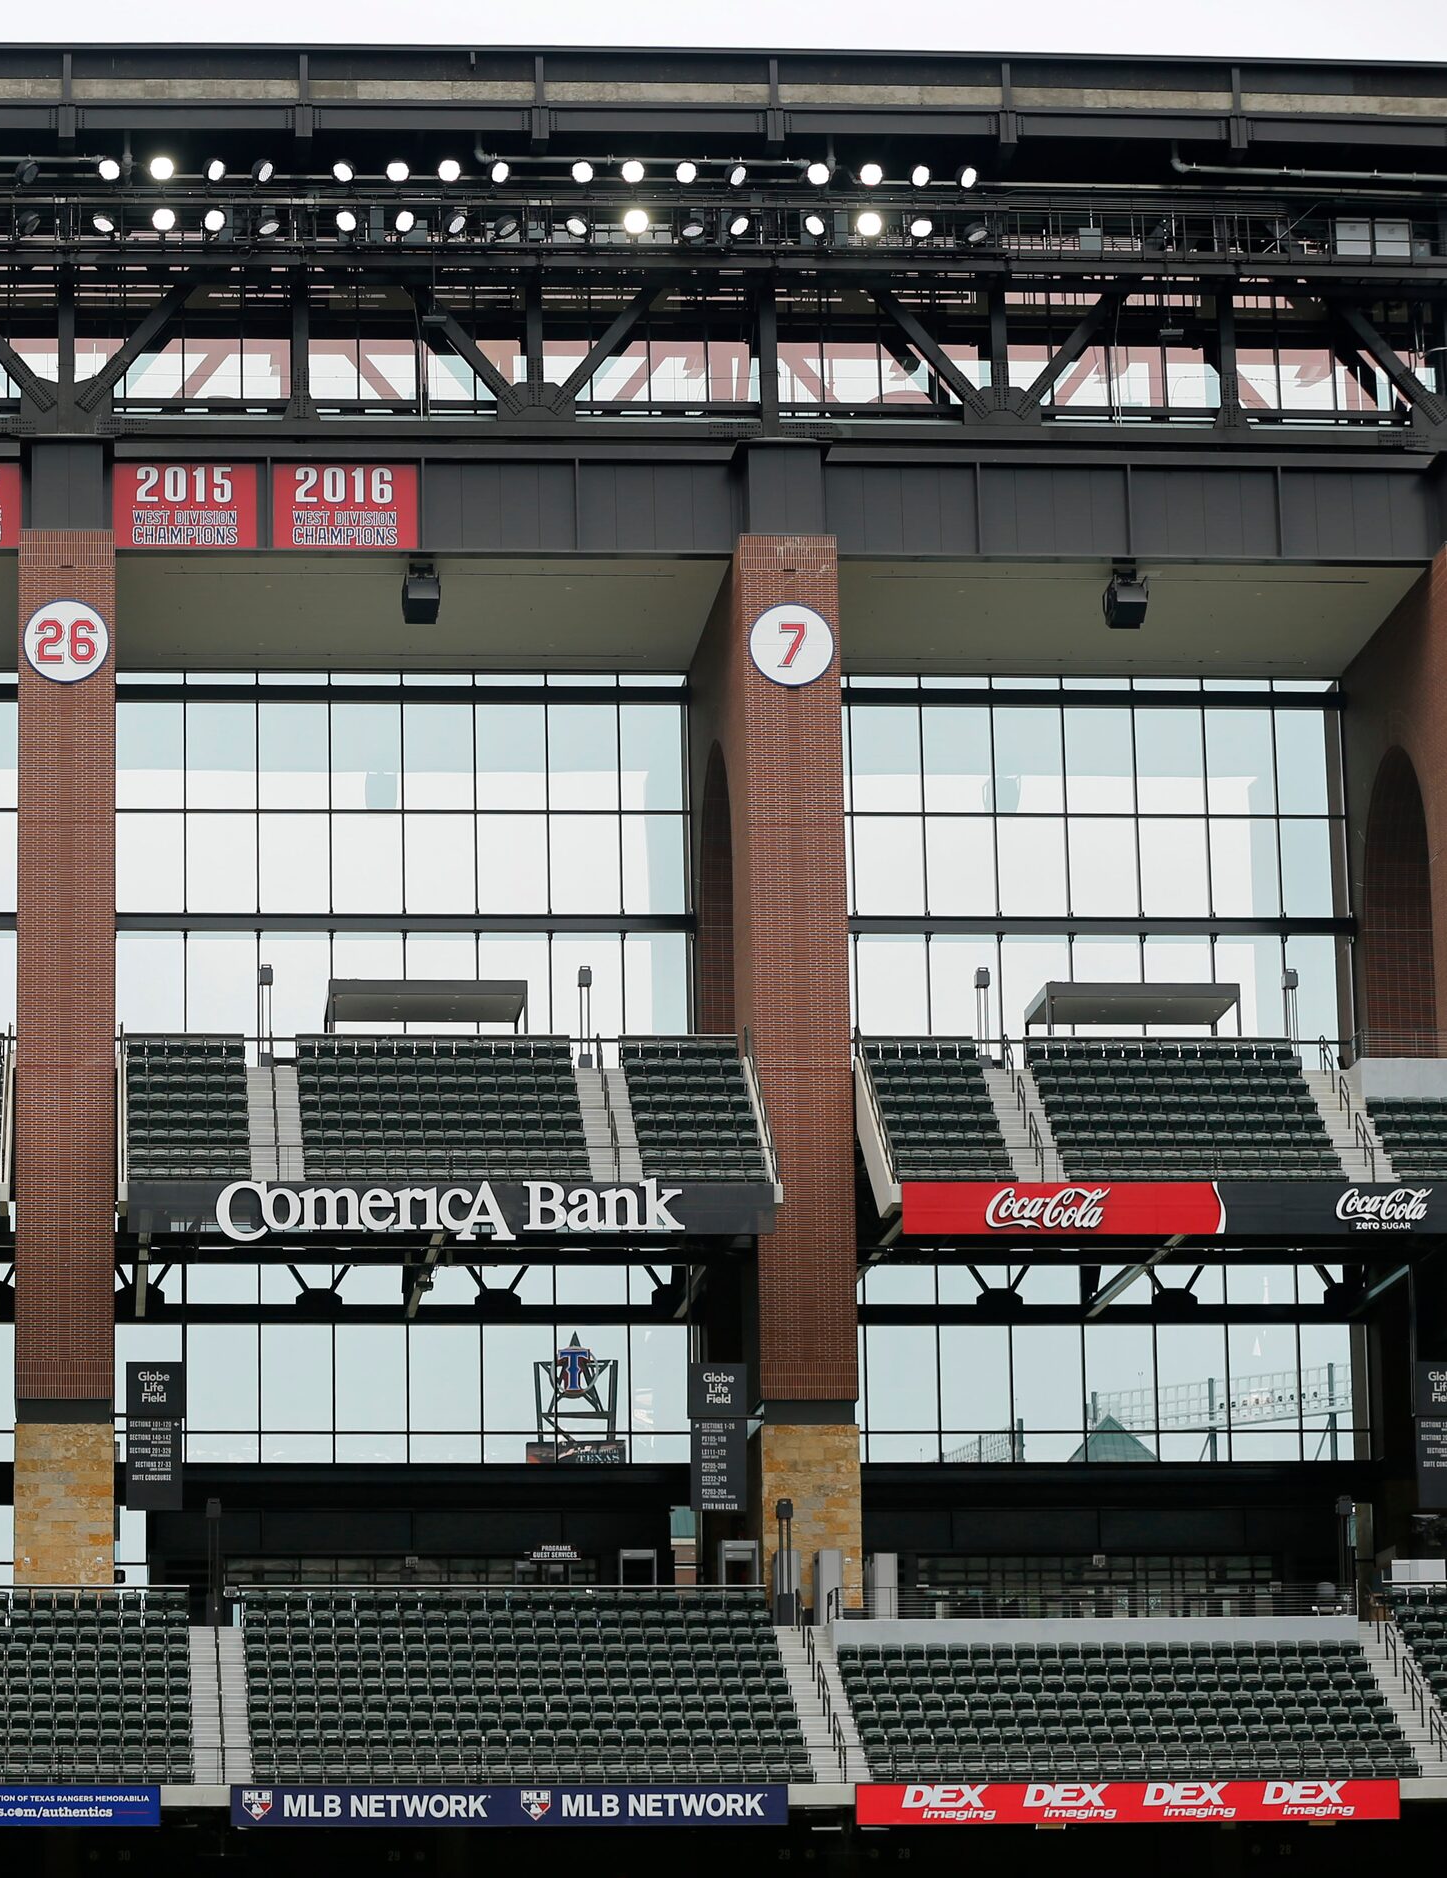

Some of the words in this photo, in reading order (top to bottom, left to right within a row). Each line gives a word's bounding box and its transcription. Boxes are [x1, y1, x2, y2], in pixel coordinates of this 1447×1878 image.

[136, 466, 232, 503] 2015
[295, 467, 393, 504] 2016
[132, 510, 170, 525] WEST
[175, 510, 237, 526] DIVISION
[292, 510, 330, 526] WEST
[335, 511, 397, 527] DIVISION
[132, 526, 238, 545] CHAMPIONS
[292, 527, 397, 546] CHAMPIONS
[34, 618, 98, 664] 26
[777, 621, 808, 667] 7
[522, 1177, 685, 1231] Bank
[985, 1187, 1110, 1229] Coca-Cola
[1335, 1188, 1433, 1221] Coca-Cola
[1355, 1222, 1380, 1230] zero
[1382, 1222, 1411, 1230] SUGAR
[137, 1371, 170, 1382] Globe
[703, 1372, 735, 1382] Globe
[144, 1382, 164, 1392] Life
[709, 1383, 729, 1393] Life
[141, 1393, 166, 1403] Field
[706, 1394, 732, 1404] Field
[1432, 1392, 1447, 1402] Fie
[901, 1784, 989, 1808] DEX
[1023, 1783, 1109, 1807] DEX
[1142, 1782, 1229, 1806] DEX
[1262, 1781, 1348, 1805] DEX
[283, 1794, 342, 1818] MLB
[350, 1794, 488, 1818] NETWORK
[561, 1794, 621, 1817] MLB
[628, 1793, 765, 1817] NETWORK
[922, 1808, 997, 1820] imaging
[1043, 1806, 1117, 1819] imaging
[1163, 1805, 1236, 1818] imaging
[1282, 1804, 1355, 1817] imaging
